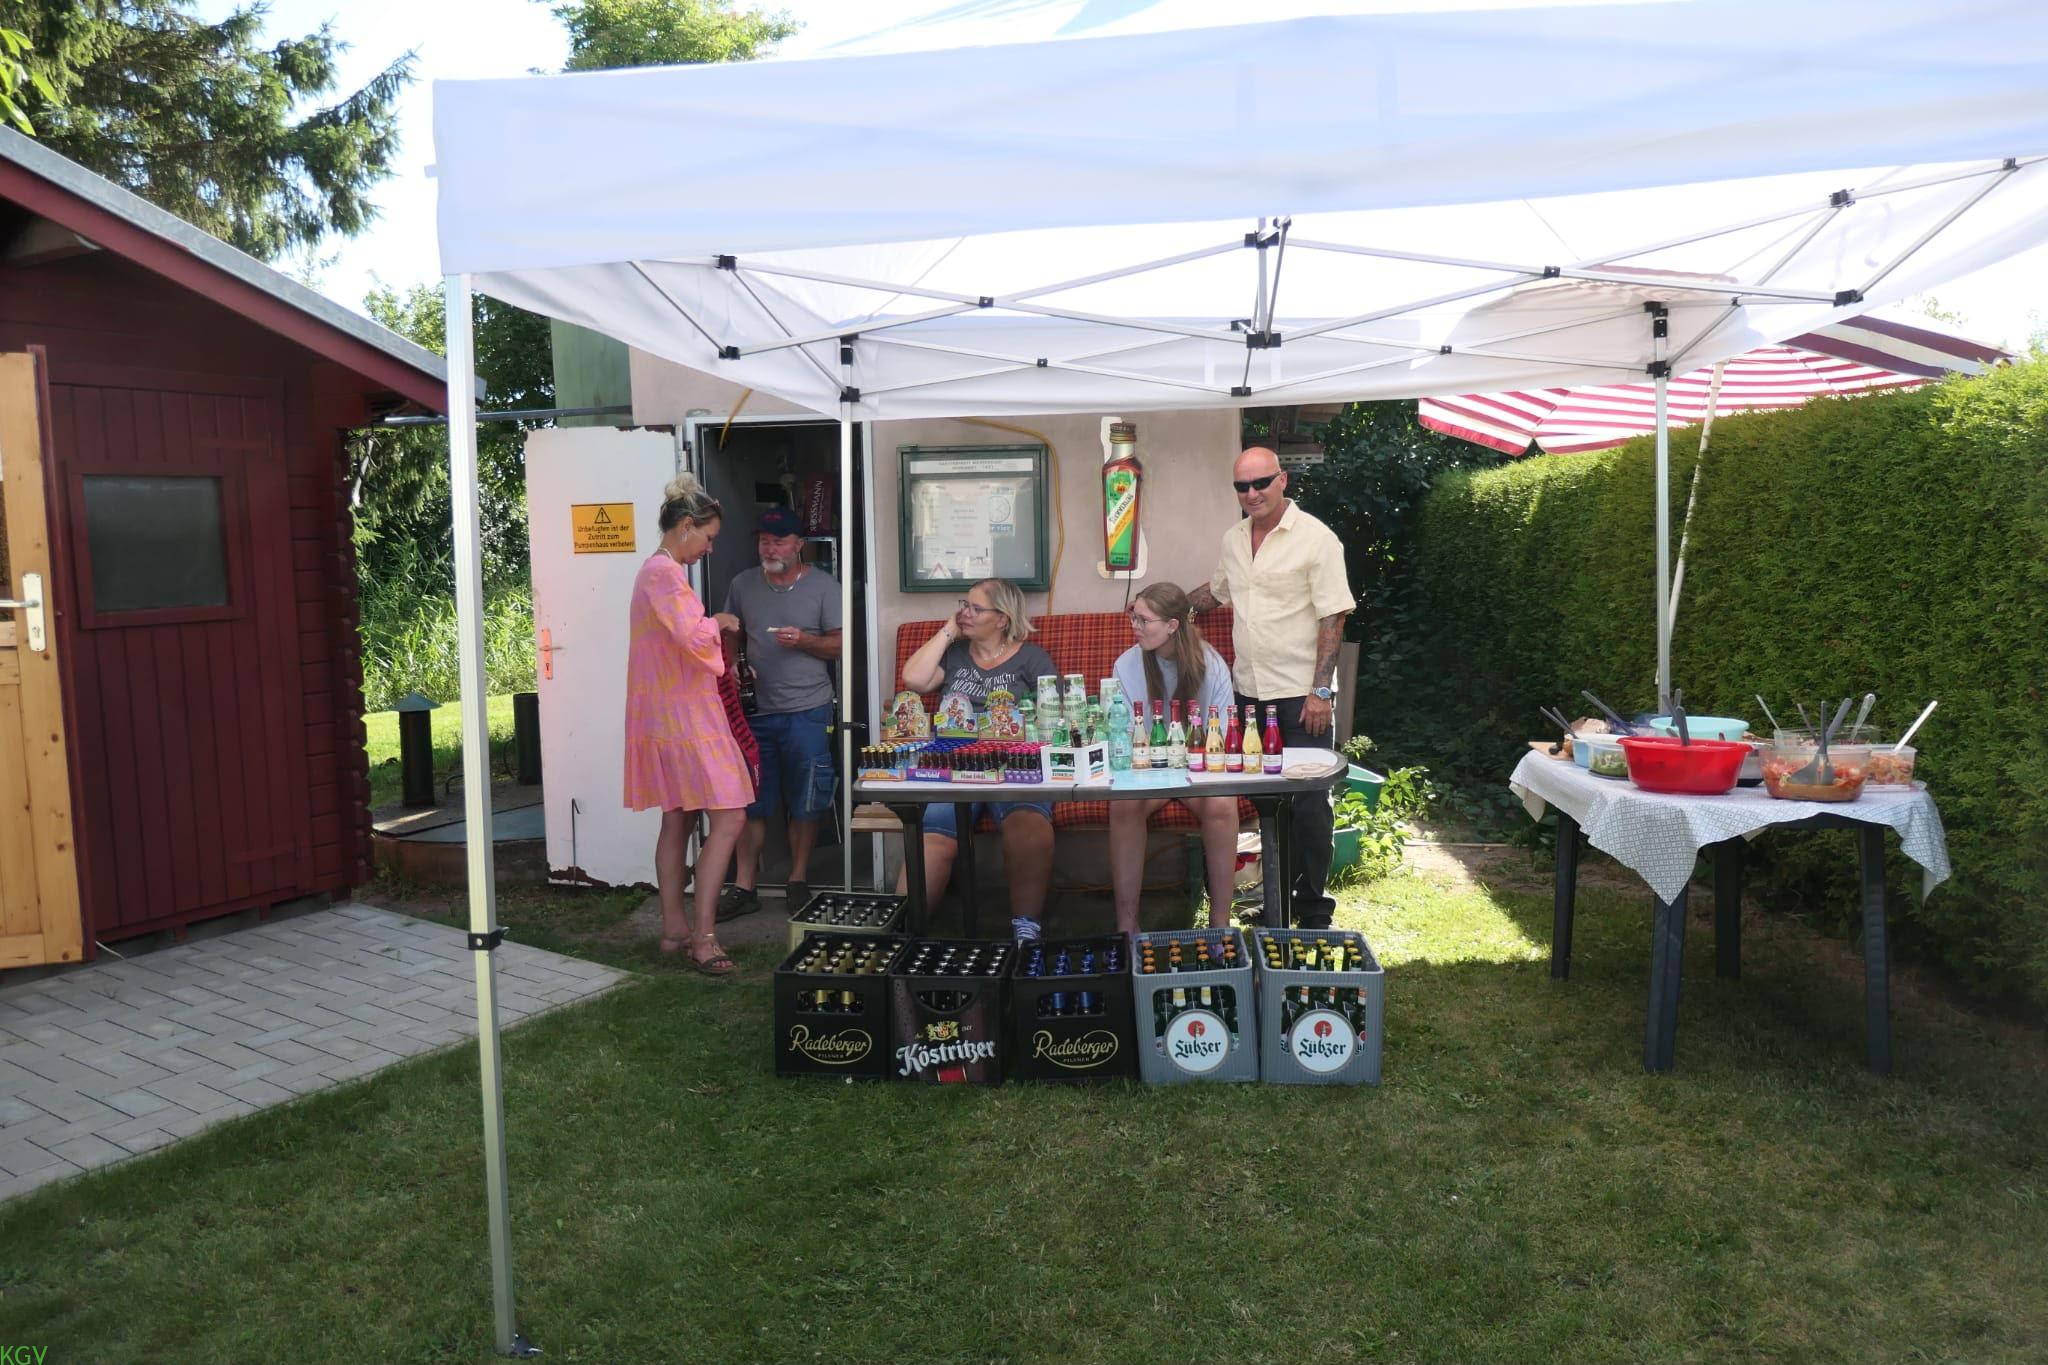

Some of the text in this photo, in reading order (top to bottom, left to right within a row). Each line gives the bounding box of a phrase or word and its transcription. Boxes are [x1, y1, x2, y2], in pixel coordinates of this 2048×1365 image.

[809, 480, 824, 532] ROSSMANN
[788, 1024, 868, 1057] Radeberger
[1032, 1030, 1114, 1060] Radeberger
[1175, 1040, 1221, 1058] Lübzer
[1299, 1038, 1346, 1058] Lübzer
[896, 1040, 996, 1076] Köstritzer
